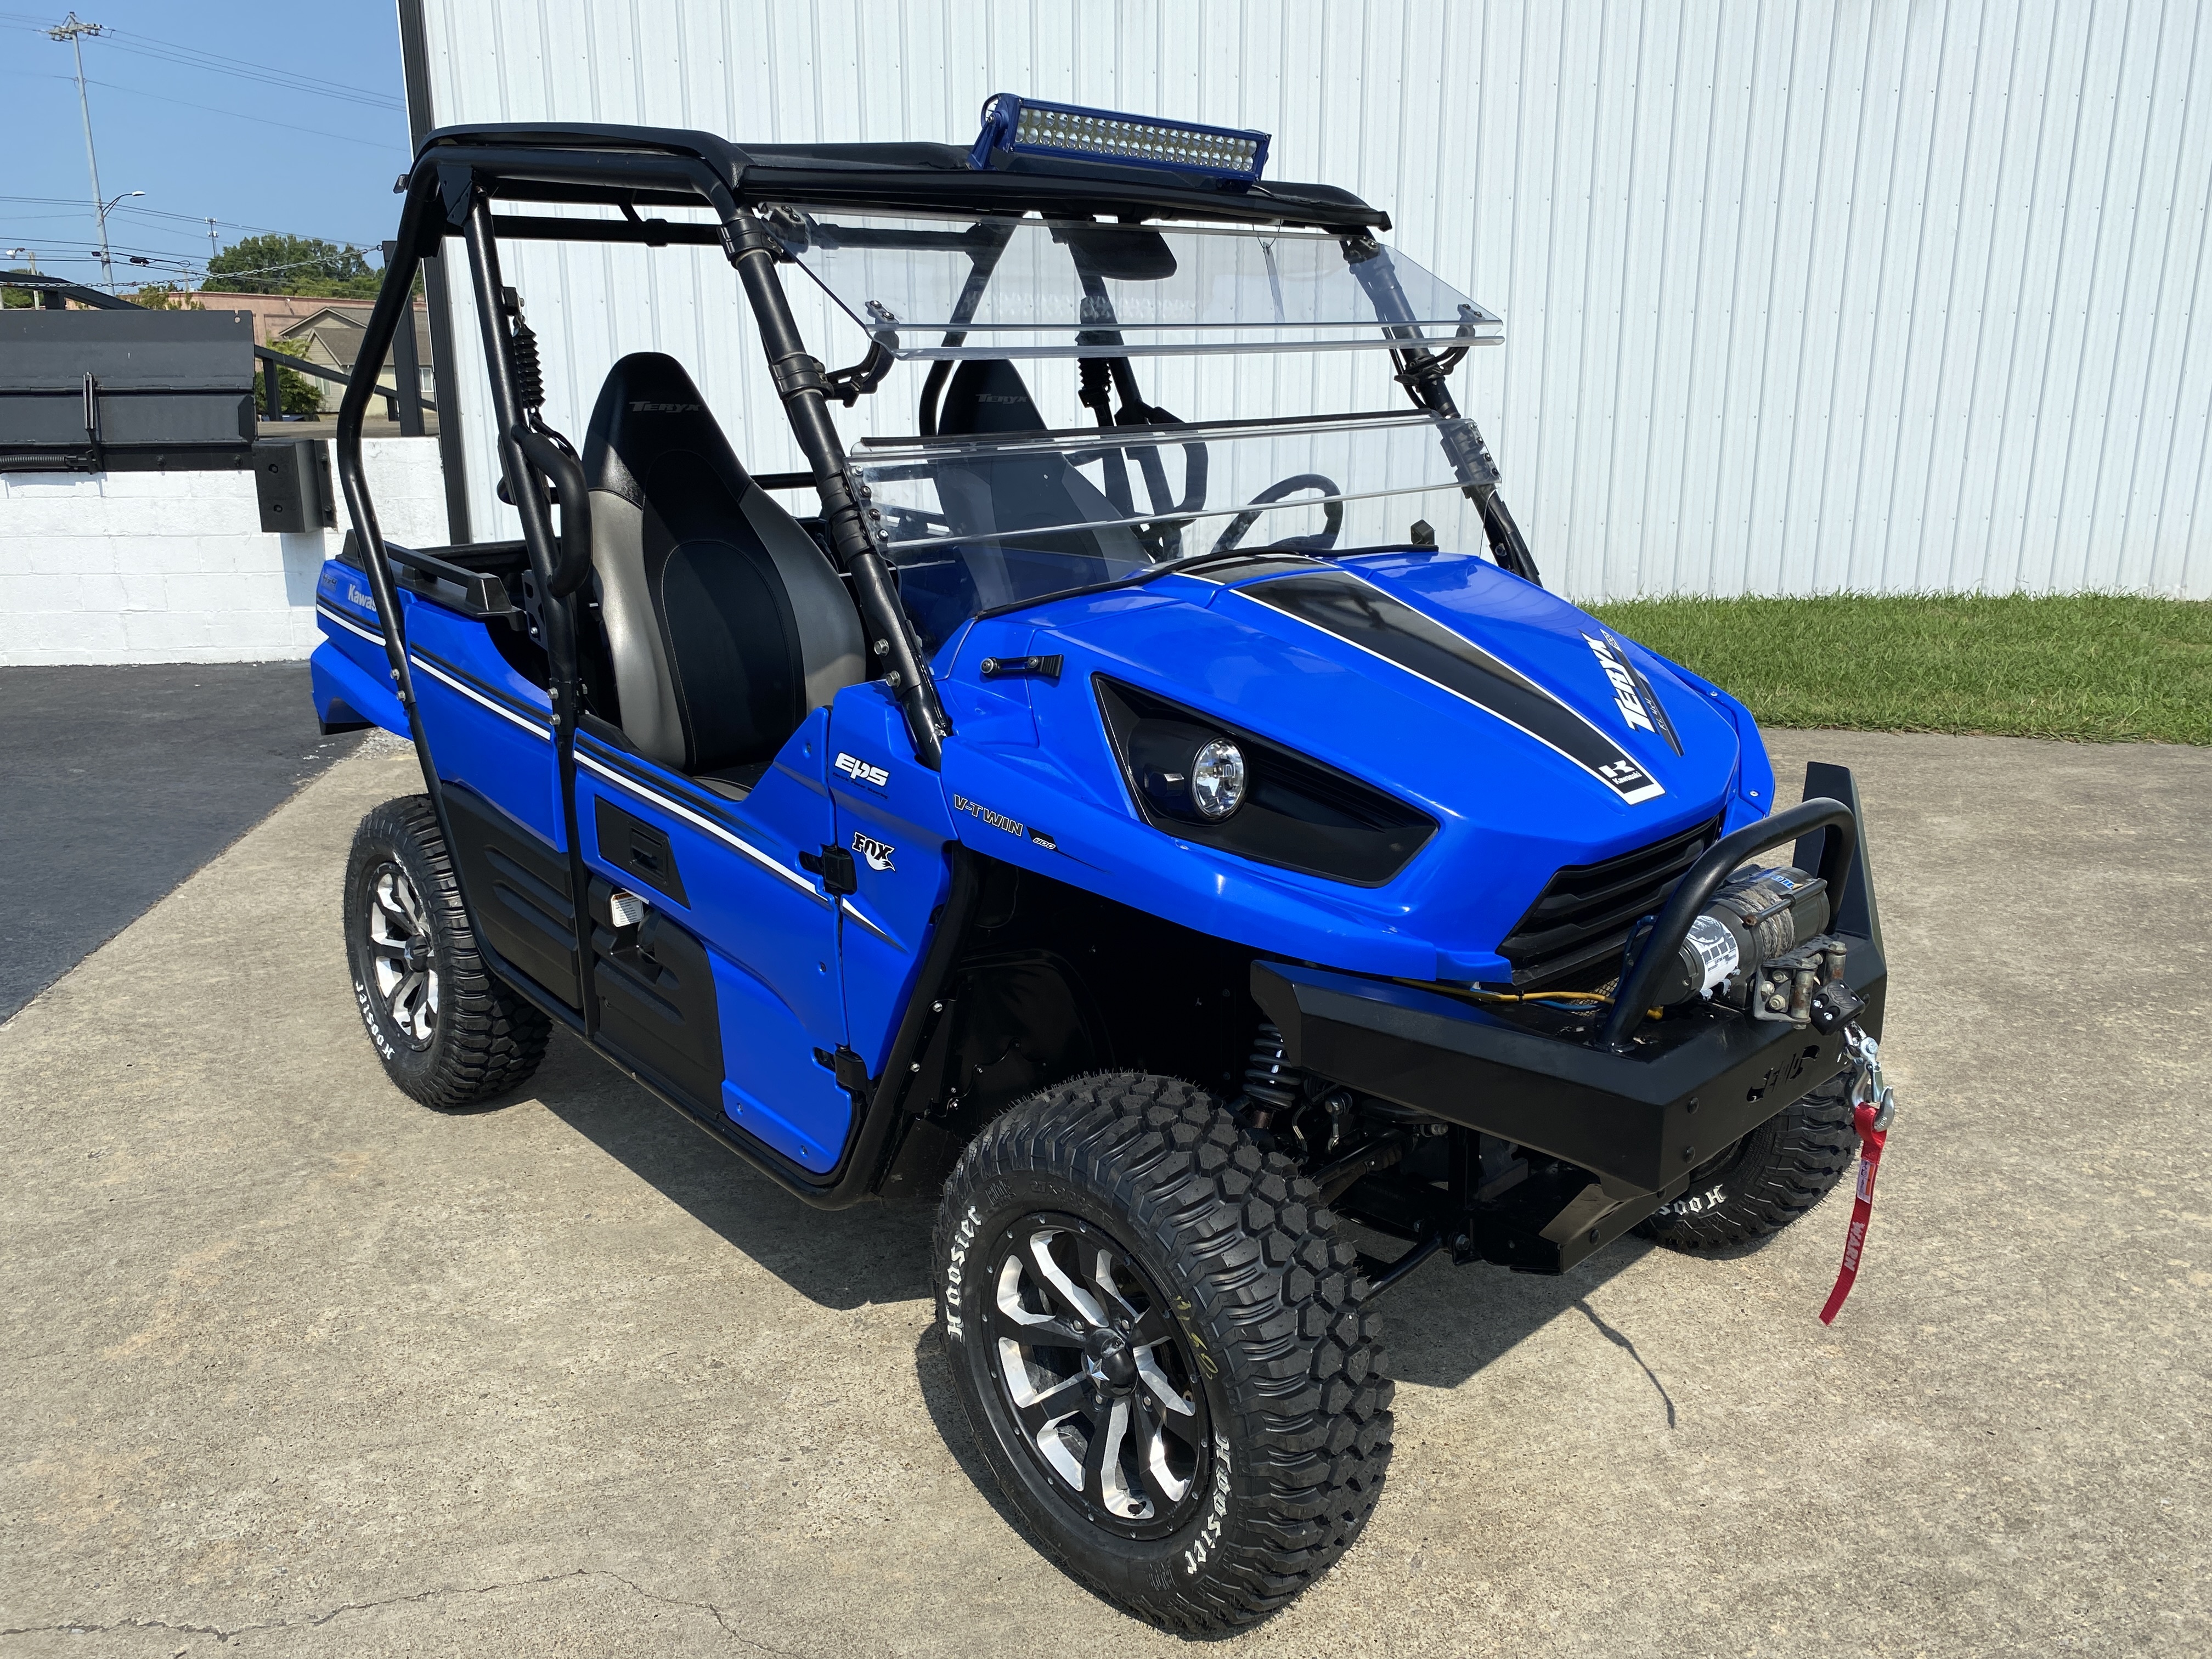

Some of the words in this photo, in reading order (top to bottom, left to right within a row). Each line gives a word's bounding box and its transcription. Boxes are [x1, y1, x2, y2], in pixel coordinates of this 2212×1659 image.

[347, 583, 377, 612] Kawas
[1612, 771, 1643, 785] Kawasaki
[953, 794, 1024, 837] V-TWIN
[851, 831, 895, 862] FOX
[1032, 837, 1056, 850] 800
[1844, 1221, 1865, 1272] WARN
